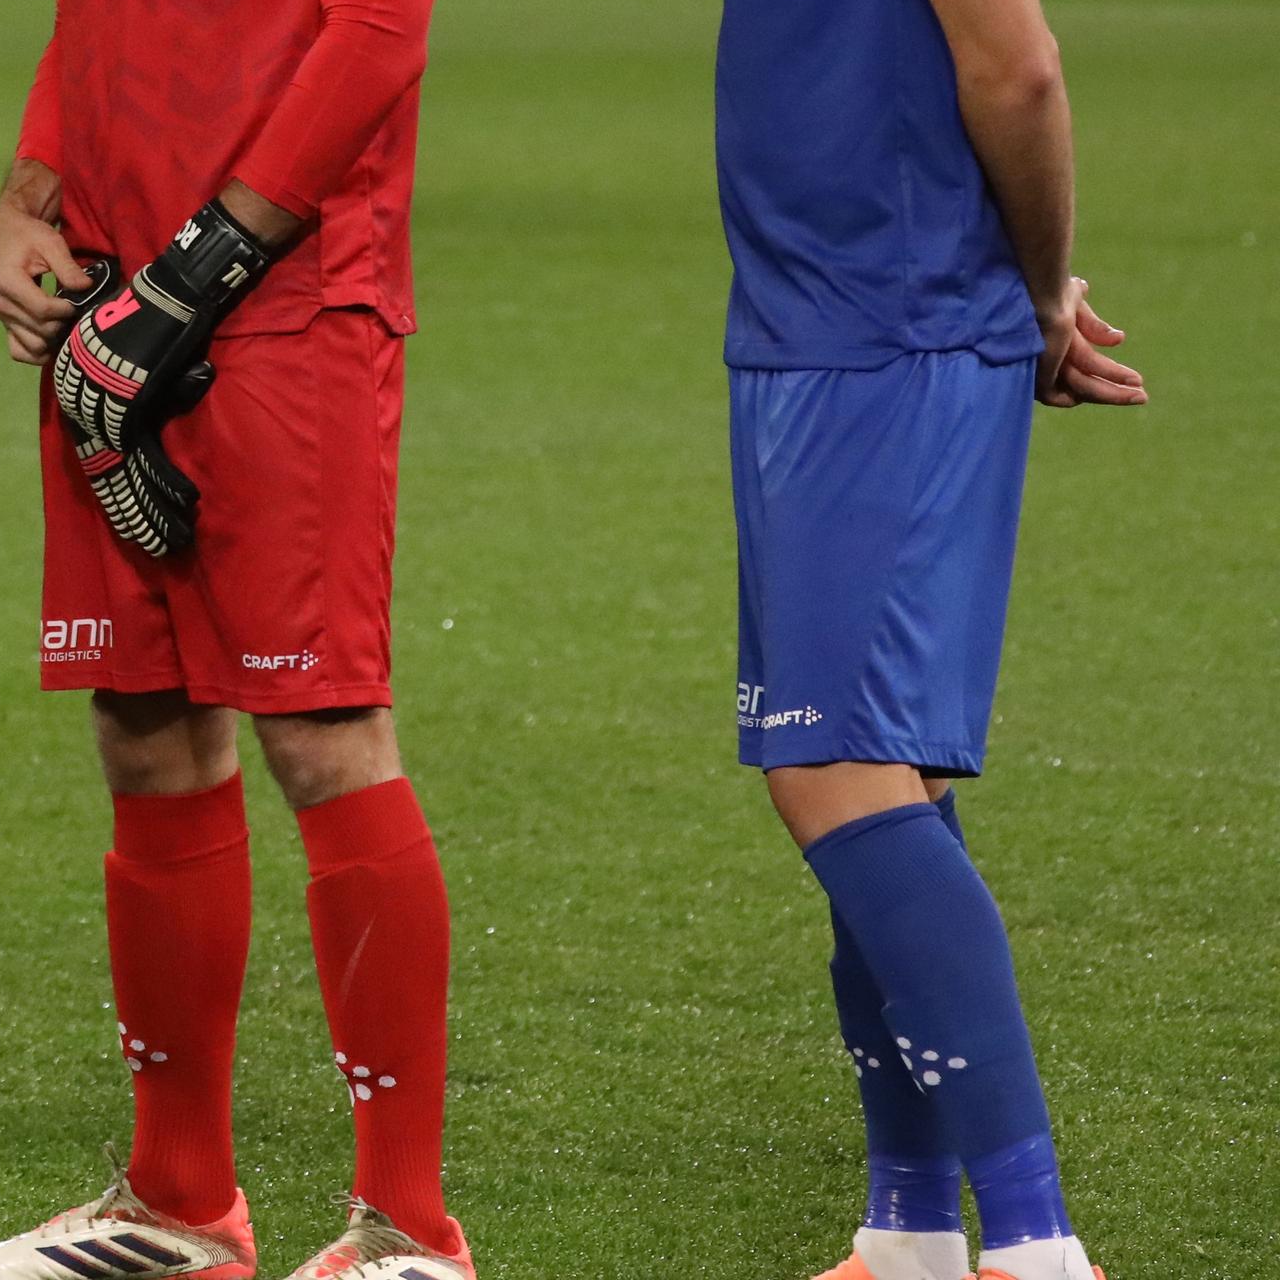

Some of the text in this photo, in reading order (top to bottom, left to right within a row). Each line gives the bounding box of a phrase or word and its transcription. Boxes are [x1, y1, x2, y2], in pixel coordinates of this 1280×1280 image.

[44, 650, 102, 662] LOGISTICS
[242, 654, 299, 669] CRAFT
[764, 710, 803, 729] CRAFT
